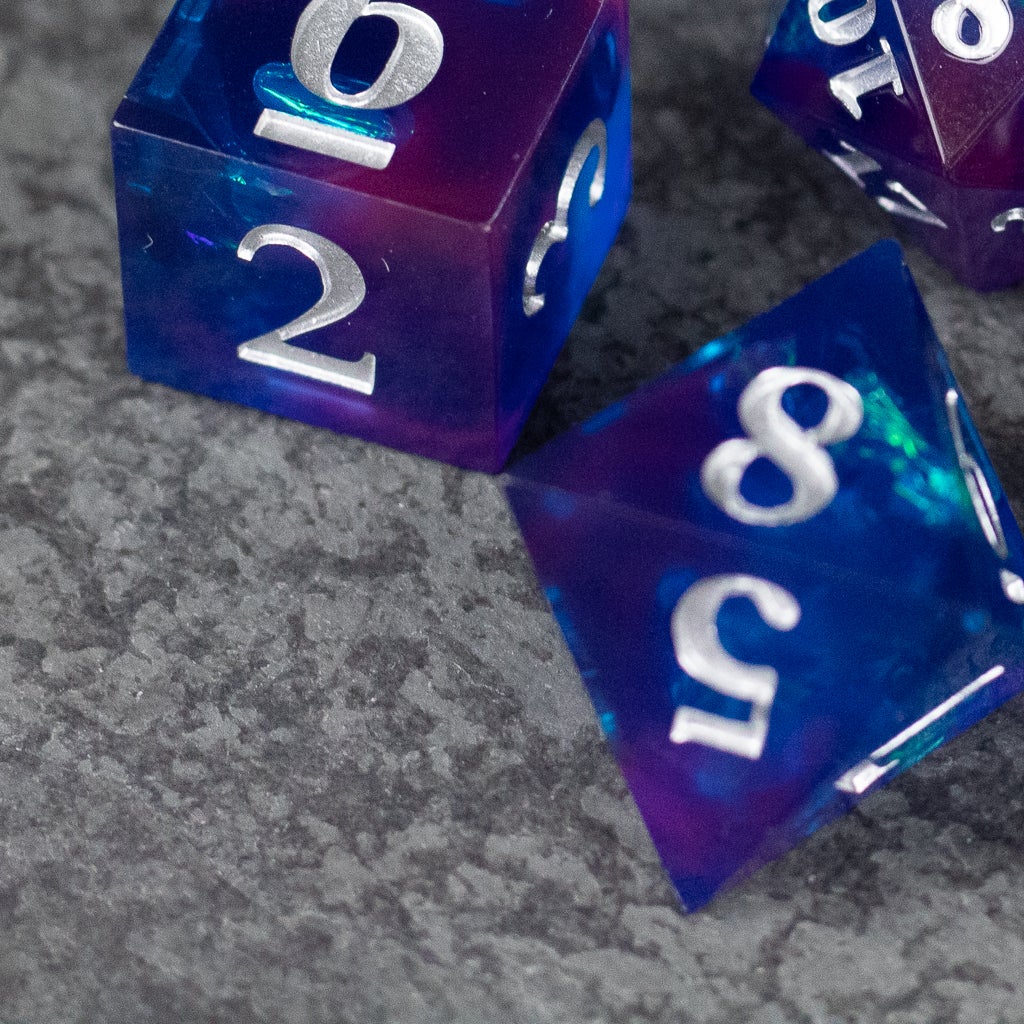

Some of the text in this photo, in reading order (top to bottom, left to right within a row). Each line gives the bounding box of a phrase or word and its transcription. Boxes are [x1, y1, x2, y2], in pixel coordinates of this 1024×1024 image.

[237, 224, 377, 395] 2
[701, 366, 864, 527] 8
[670, 574, 800, 760] 5
